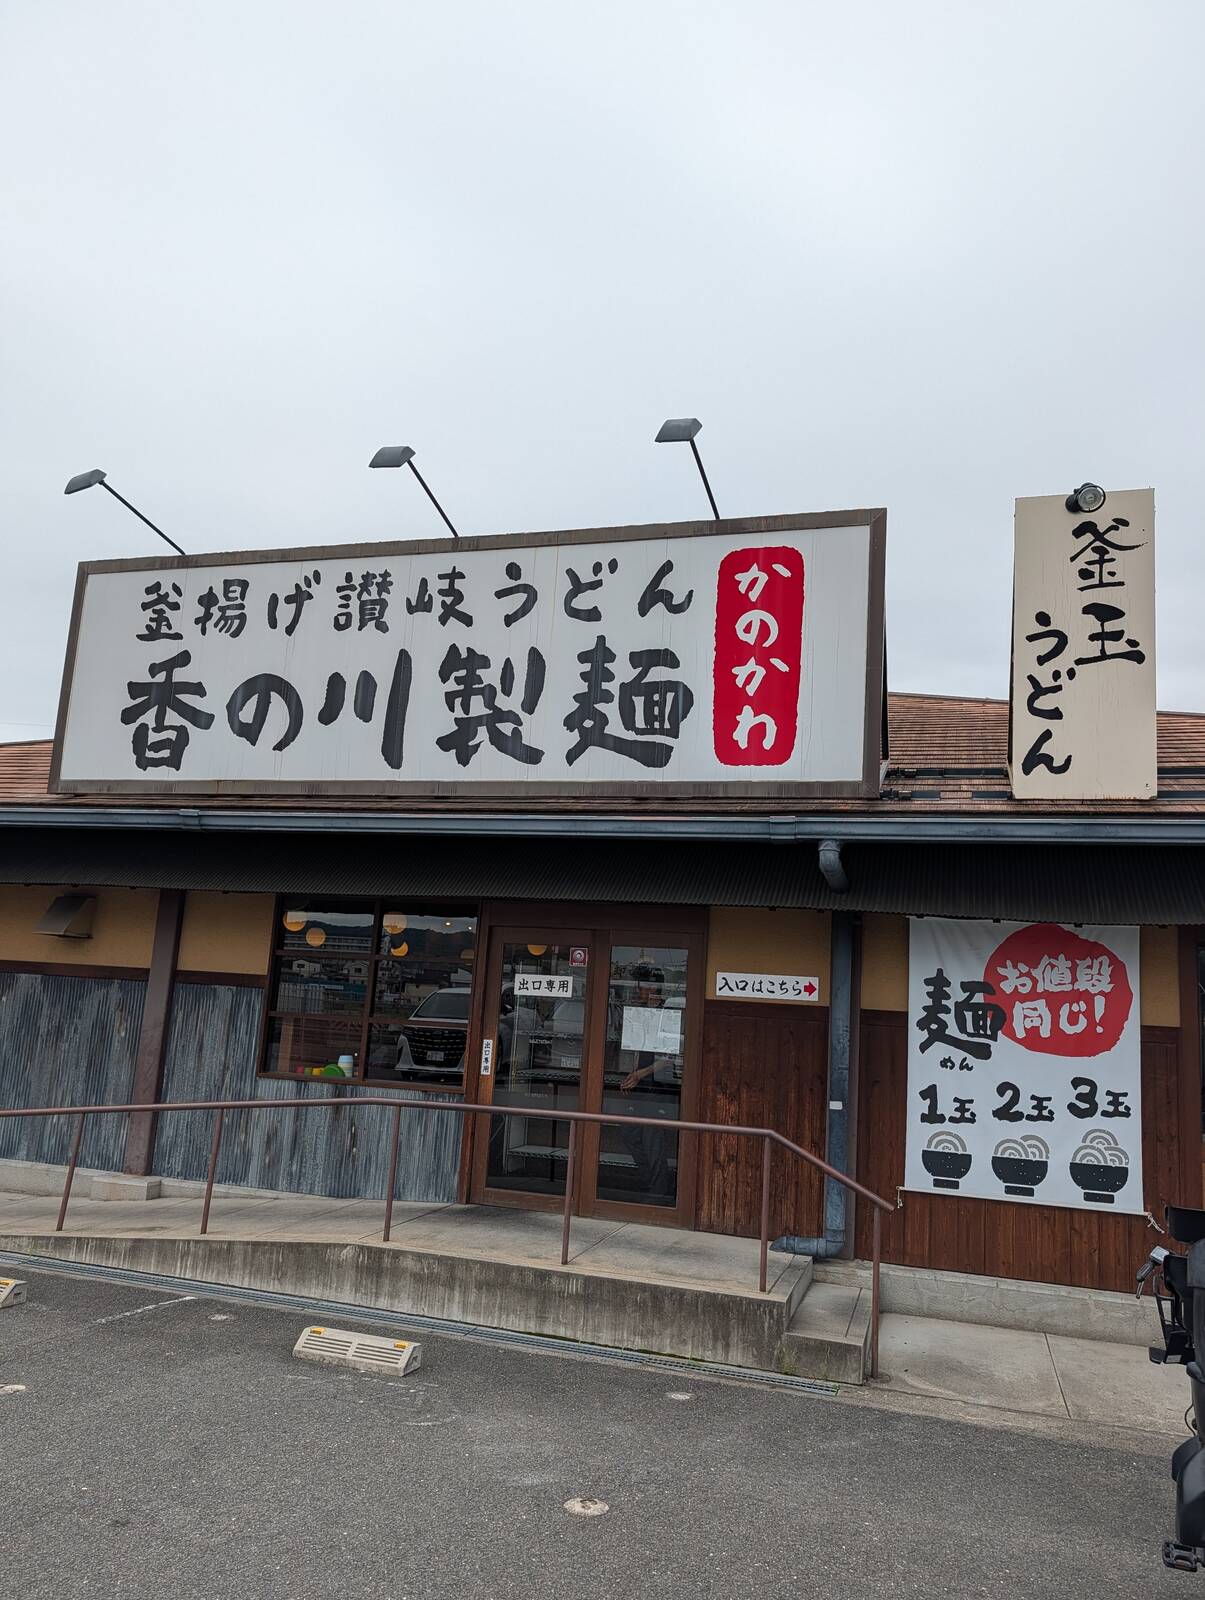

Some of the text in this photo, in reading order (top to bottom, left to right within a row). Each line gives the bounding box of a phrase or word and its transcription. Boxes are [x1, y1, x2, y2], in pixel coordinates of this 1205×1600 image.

[136, 558, 693, 642] 釜揚げ讃岐うどん
[1070, 518, 1148, 665] 釜玉
[731, 563, 792, 751] かのかわ
[121, 635, 695, 771] 香の川製麺
[1022, 611, 1076, 776] うどん
[517, 978, 570, 993] 出口専用
[718, 976, 802, 997] 入口はこちら
[997, 953, 1115, 994] お値段
[916, 968, 1007, 1060] 麺
[940, 1056, 974, 1072] めん
[919, 1084, 976, 1124] 1玉
[992, 1081, 1055, 1122] 2玉
[1067, 1077, 1132, 1119] 3玉
